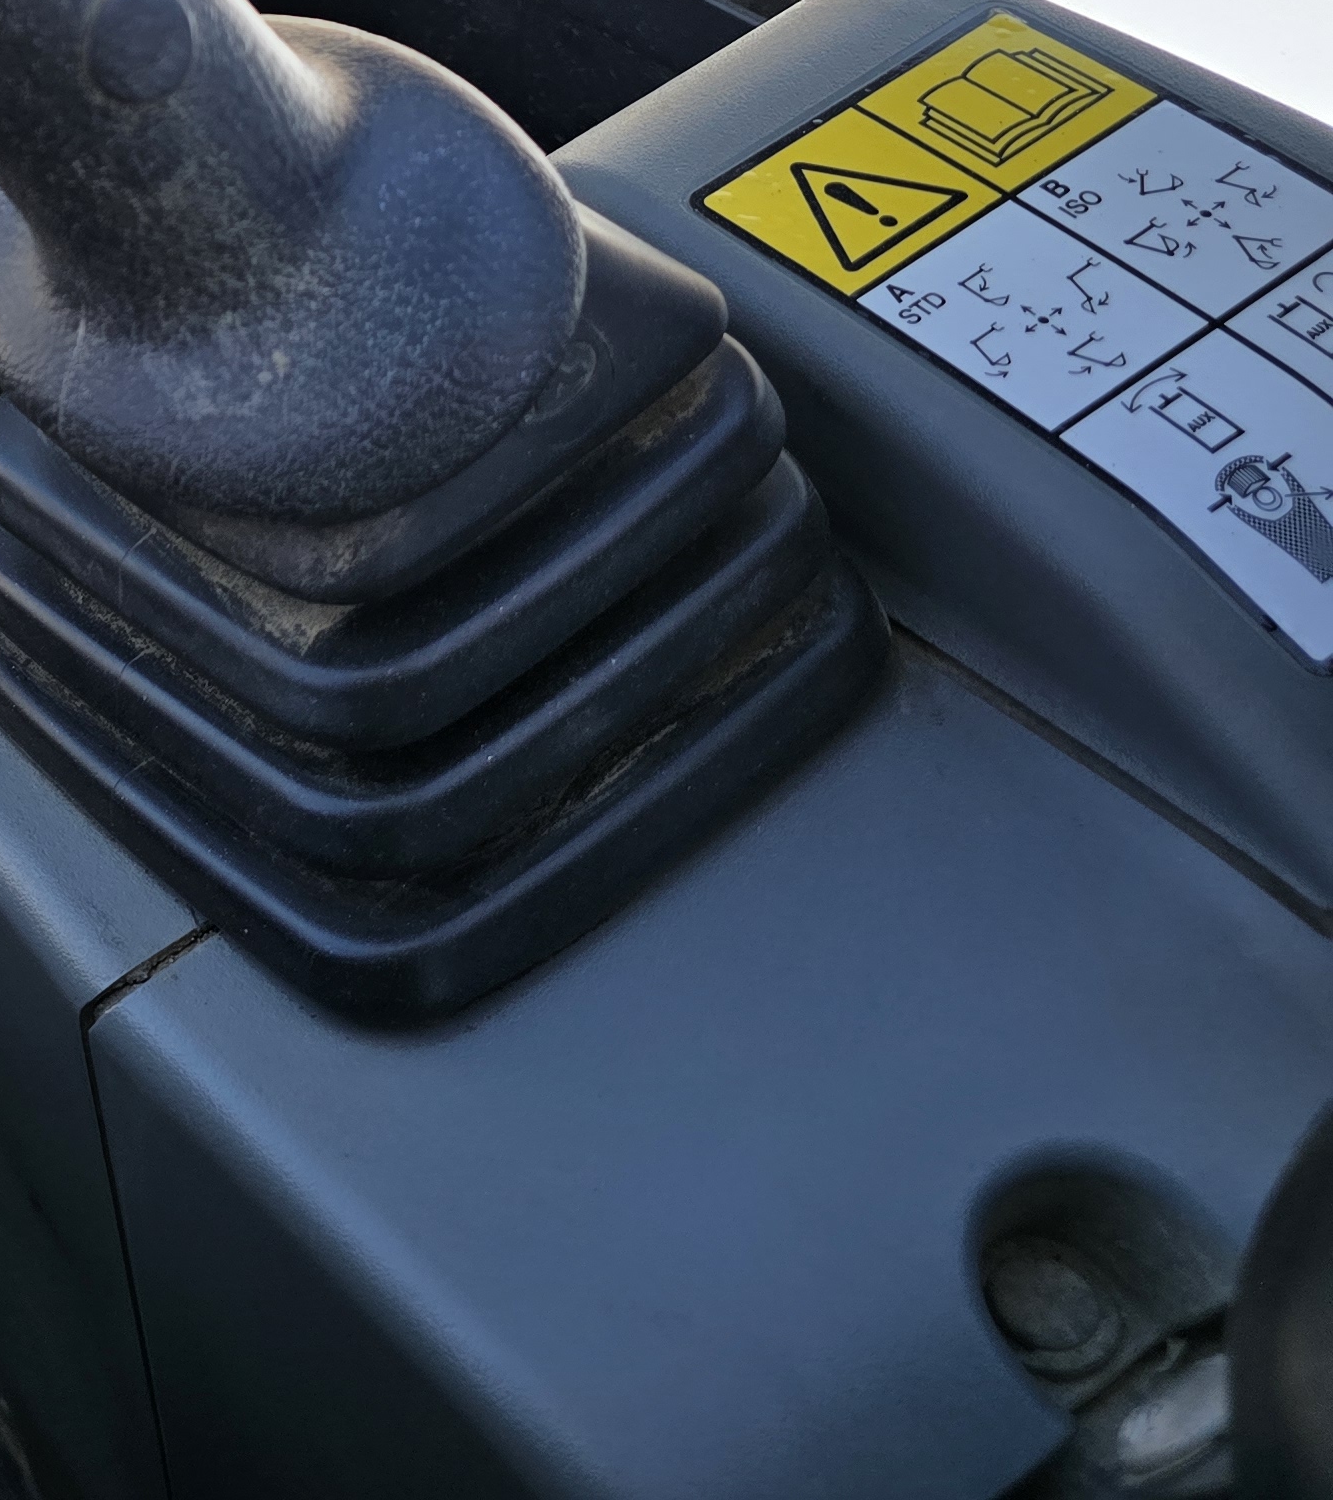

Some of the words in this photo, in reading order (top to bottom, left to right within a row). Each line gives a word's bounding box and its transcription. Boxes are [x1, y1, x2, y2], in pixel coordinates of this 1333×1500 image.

[1039, 178, 1071, 199] B
[1057, 190, 1103, 219] ISO
[885, 283, 916, 304] A
[898, 291, 947, 325] STD
[1306, 318, 1333, 340] AUX
[1186, 411, 1216, 433] AUX
